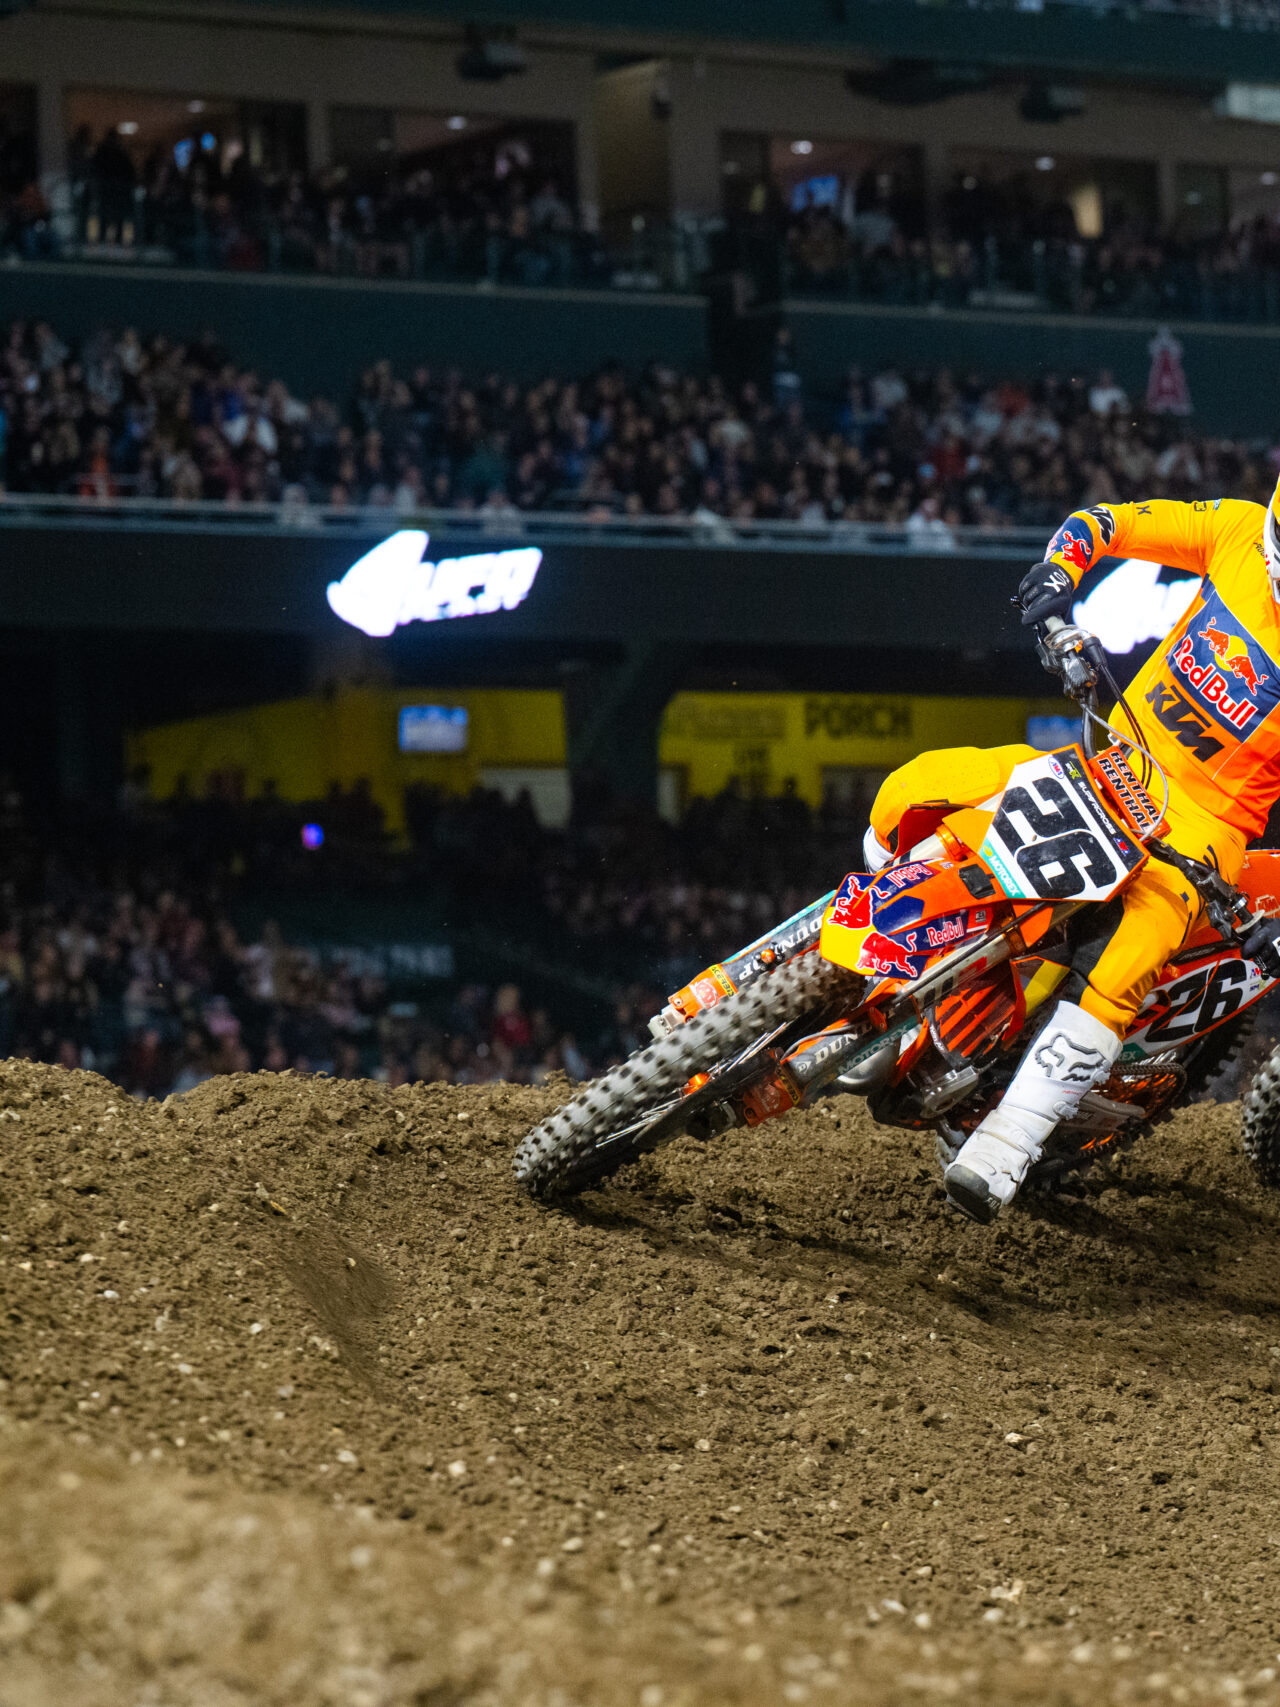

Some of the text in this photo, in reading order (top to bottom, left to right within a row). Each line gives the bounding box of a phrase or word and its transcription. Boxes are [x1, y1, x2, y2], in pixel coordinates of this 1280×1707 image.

[1144, 680, 1226, 763] KTM
[992, 776, 1117, 899] 26
[1098, 757, 1155, 839] RENTHAL
[988, 854, 1020, 897] MOTOREX
[738, 915, 824, 981] DUNOP
[927, 917, 964, 947] RedBull
[1144, 958, 1248, 1043] 26
